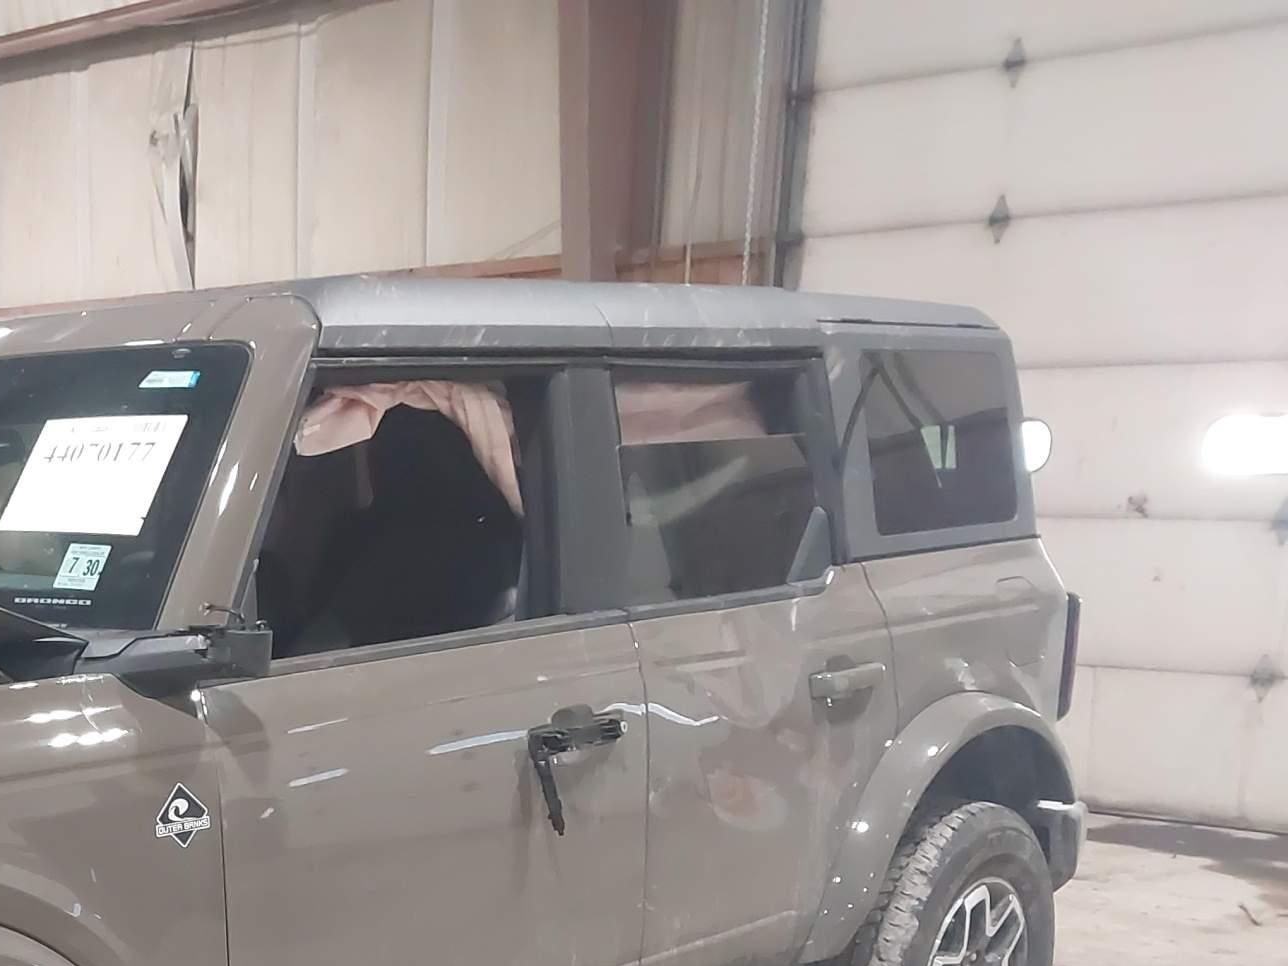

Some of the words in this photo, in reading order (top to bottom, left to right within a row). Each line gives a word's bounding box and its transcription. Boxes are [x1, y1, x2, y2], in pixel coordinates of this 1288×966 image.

[67, 556, 80, 574] 7
[81, 559, 100, 577] 30
[14, 597, 92, 606] BRONCO
[158, 824, 183, 834] OUTER
[184, 819, 208, 830] BANKS
